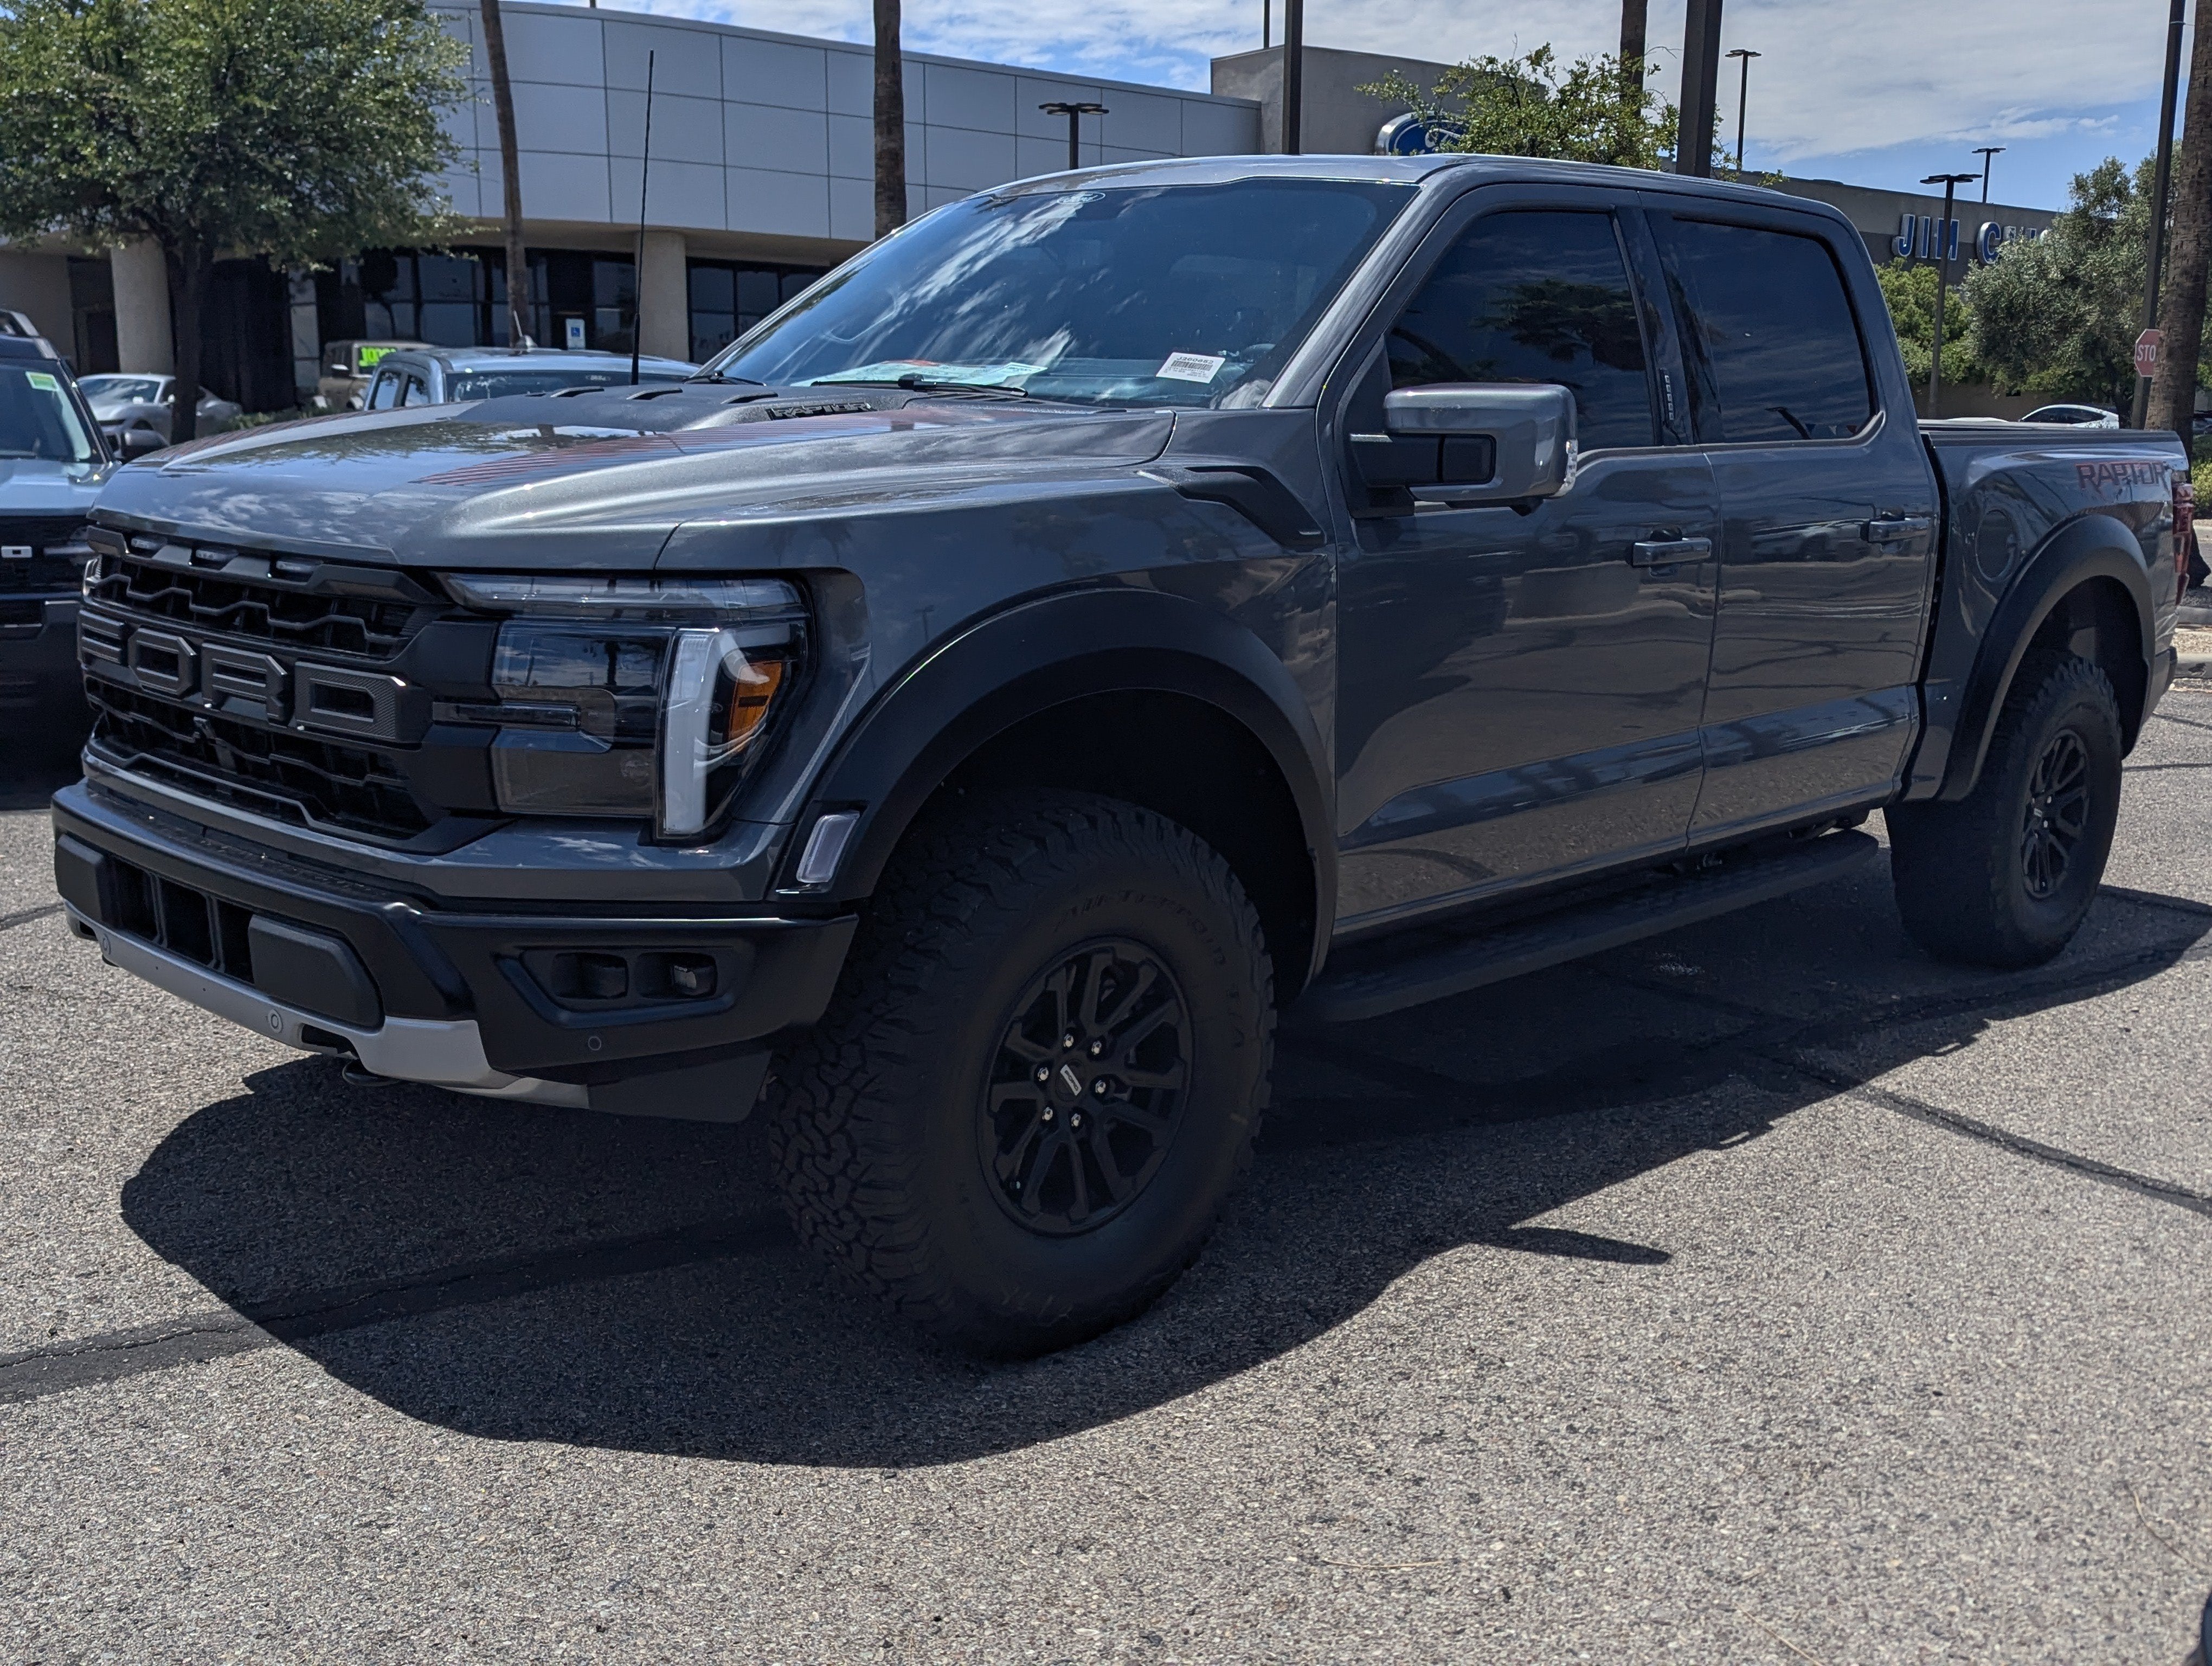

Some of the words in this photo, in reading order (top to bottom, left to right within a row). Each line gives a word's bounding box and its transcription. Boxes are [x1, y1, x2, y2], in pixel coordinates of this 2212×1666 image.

[1892, 213, 1960, 261] JIM
[2136, 344, 2157, 361] STO
[771, 401, 873, 419] RAPTOR
[2075, 462, 2170, 495] RAPTOR
[77, 608, 404, 741] FORD
